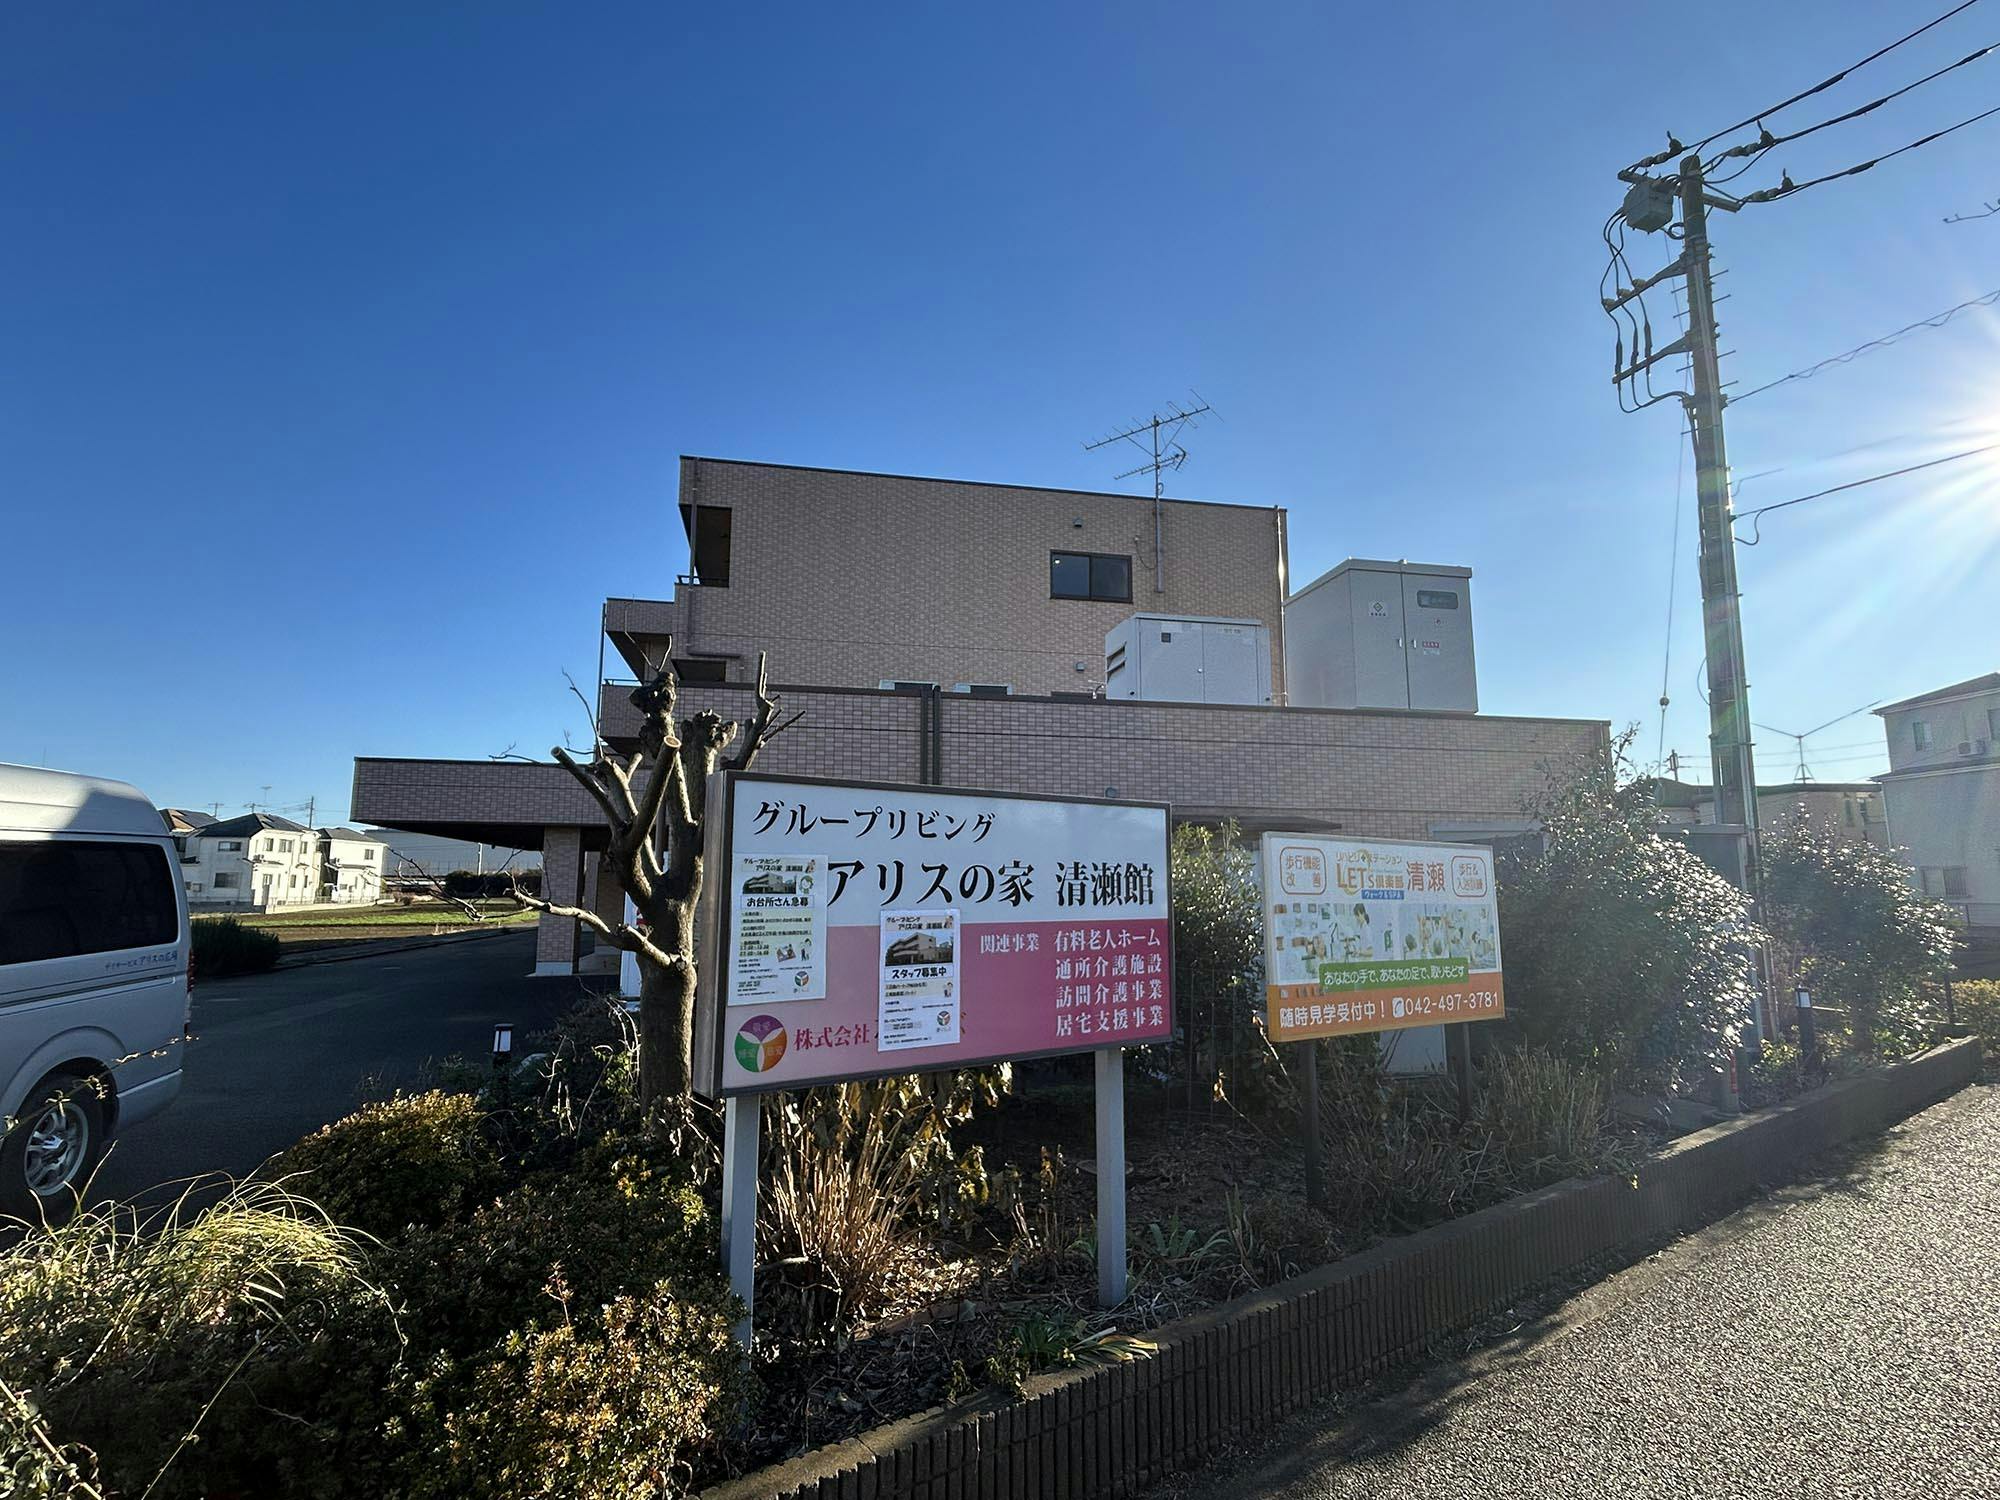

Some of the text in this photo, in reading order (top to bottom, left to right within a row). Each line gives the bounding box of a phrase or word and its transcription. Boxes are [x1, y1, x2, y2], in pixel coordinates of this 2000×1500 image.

[752, 799, 997, 843] グループリビング
[827, 859, 1155, 908] アリスの家 清瀬館
[1406, 861, 1446, 892] 清瀬
[747, 896, 808, 907] お台所さん急募
[980, 932, 1161, 954] 関連事業 有料老人ホーム
[892, 968, 947, 979] スタッフ募集中
[1055, 954, 1162, 980] 通所介護施設
[1055, 983, 1163, 1010] 訪問介護事業
[1405, 992, 1498, 1015] 042-497-3781
[1055, 1009, 1164, 1037] 居宅支援事業
[793, 1024, 870, 1051] 株式会社
